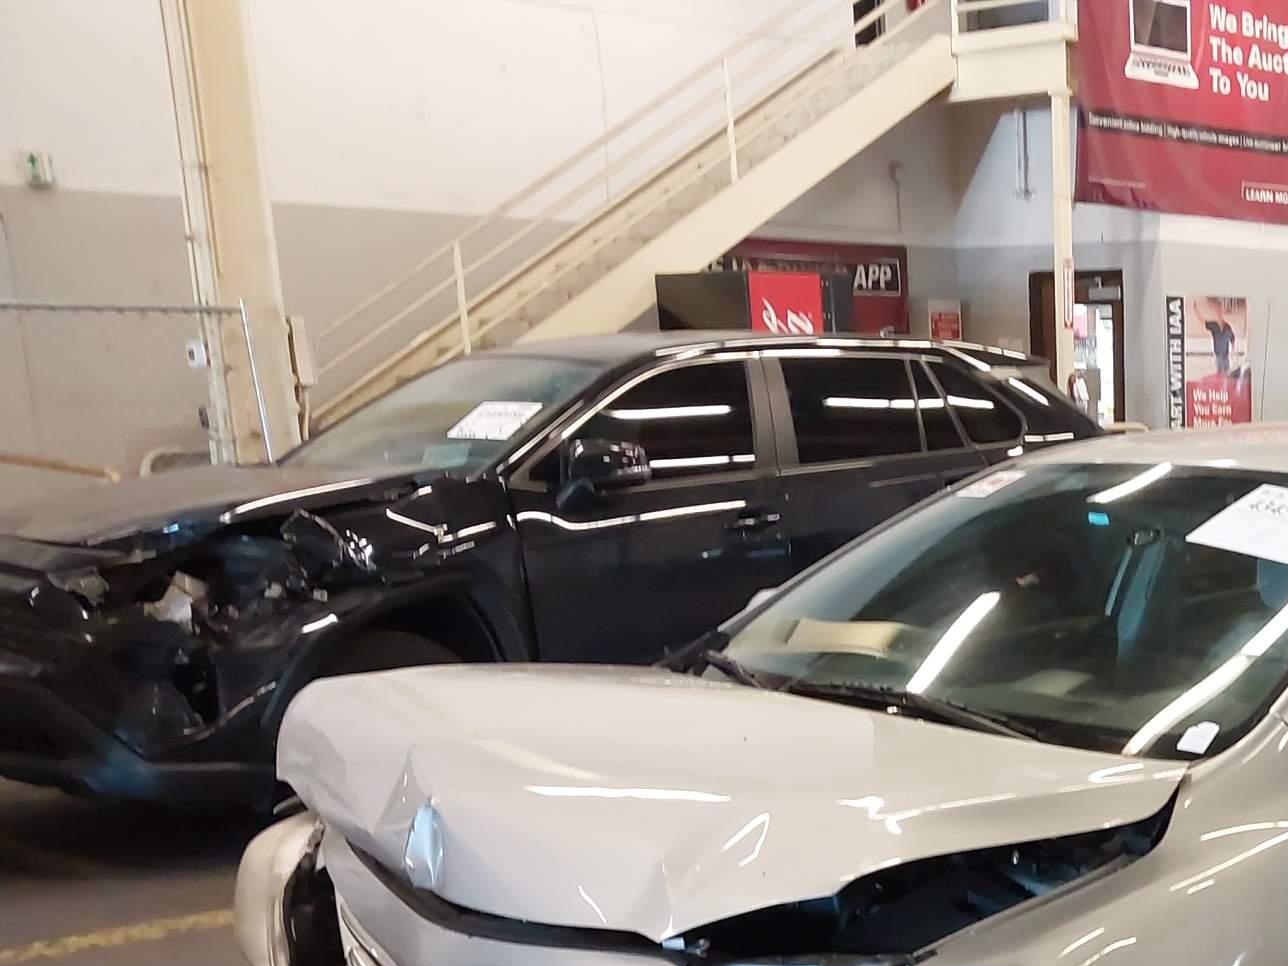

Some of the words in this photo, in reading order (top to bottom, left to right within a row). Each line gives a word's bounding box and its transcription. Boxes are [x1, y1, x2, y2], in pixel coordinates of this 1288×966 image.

[1209, 3, 1237, 34] We
[1209, 35, 1243, 66] The
[1209, 67, 1231, 95] To
[1236, 71, 1269, 102] You
[1245, 187, 1273, 203] LEARN
[853, 264, 892, 290] APP
[1168, 298, 1182, 335] IAA
[1169, 338, 1182, 391] WITH
[1193, 388, 1206, 401] We
[1208, 388, 1228, 403] Help
[1193, 402, 1210, 415] You
[1212, 403, 1232, 415] Earn
